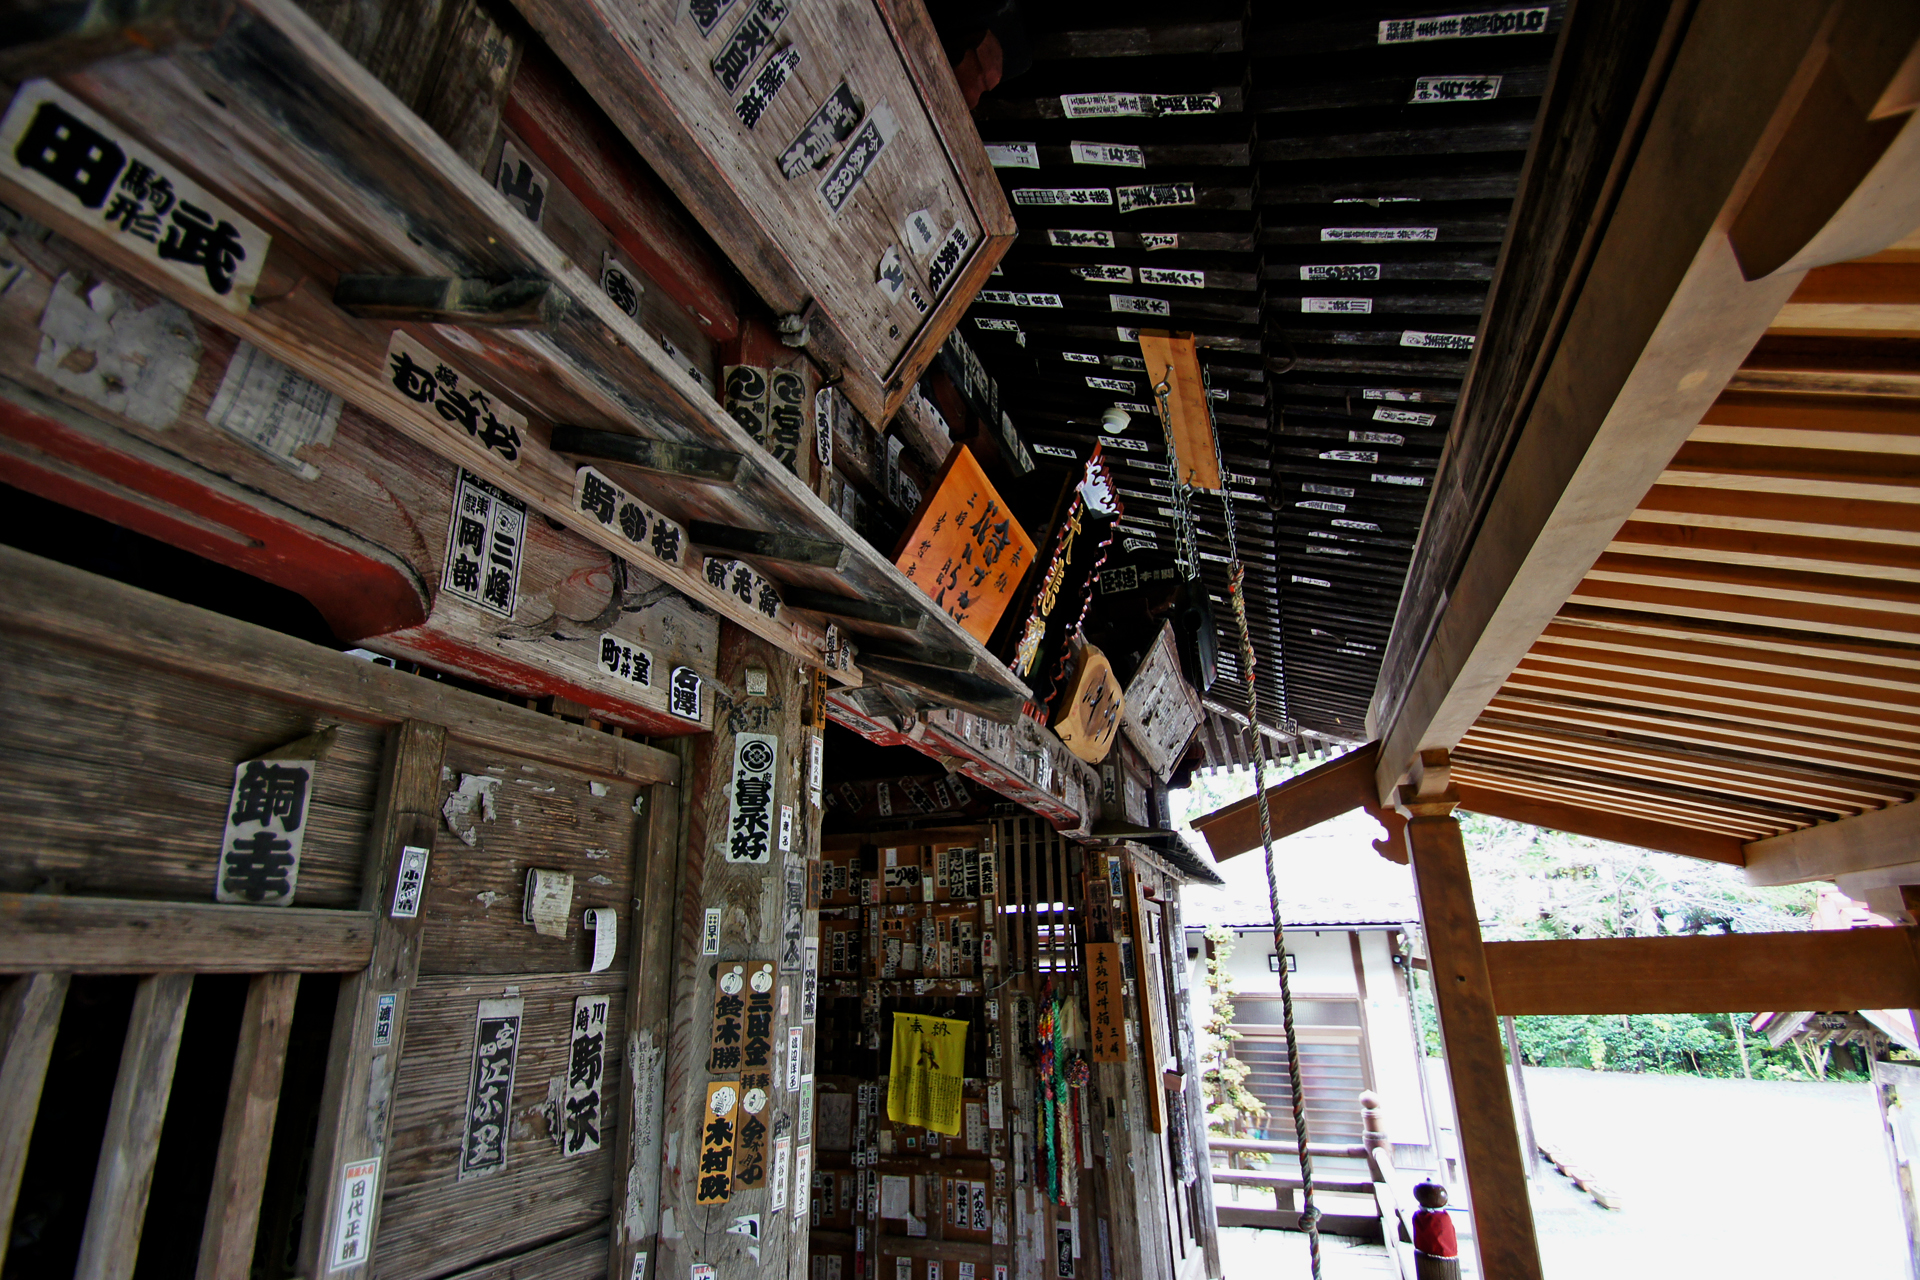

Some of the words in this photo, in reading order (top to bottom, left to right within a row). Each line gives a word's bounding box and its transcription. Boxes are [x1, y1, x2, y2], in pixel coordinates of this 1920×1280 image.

[104, 158, 176, 244] 駒形
[453, 516, 485, 591] 岡部
[994, 545, 1023, 593] 奉納
[674, 669, 698, 715] 石澤
[707, 925, 717, 950] 早川
[576, 1002, 606, 1031] 川崎
[711, 995, 744, 1069] 鈴木勝
[910, 1016, 951, 1037] 奉納
